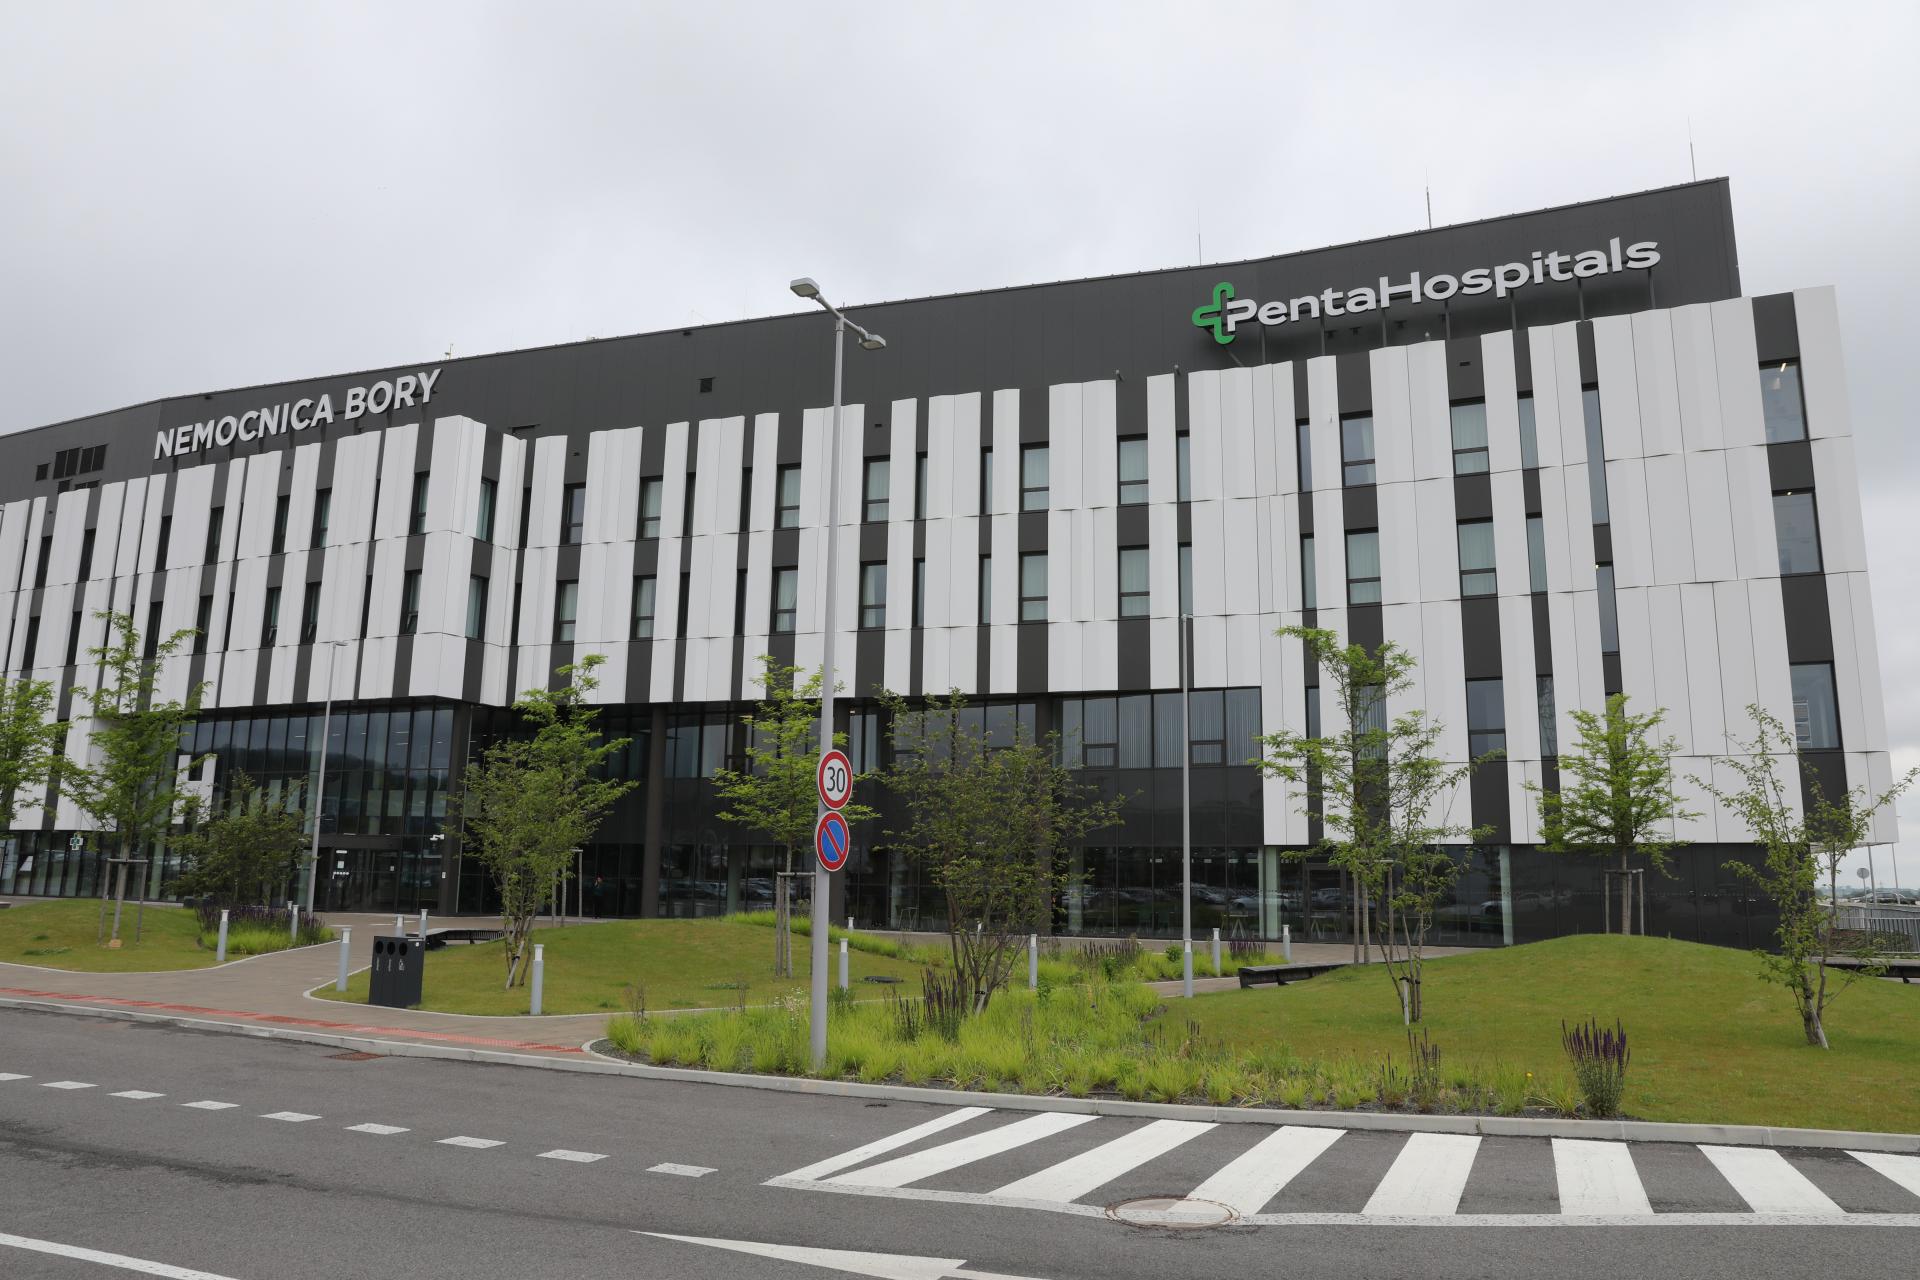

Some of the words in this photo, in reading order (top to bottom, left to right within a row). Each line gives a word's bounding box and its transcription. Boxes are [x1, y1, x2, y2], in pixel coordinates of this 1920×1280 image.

[1227, 237, 1661, 332] PentaHospitals
[154, 394, 334, 460] NEMOCNICA
[344, 368, 442, 420] BORY
[826, 766, 846, 793] 30
